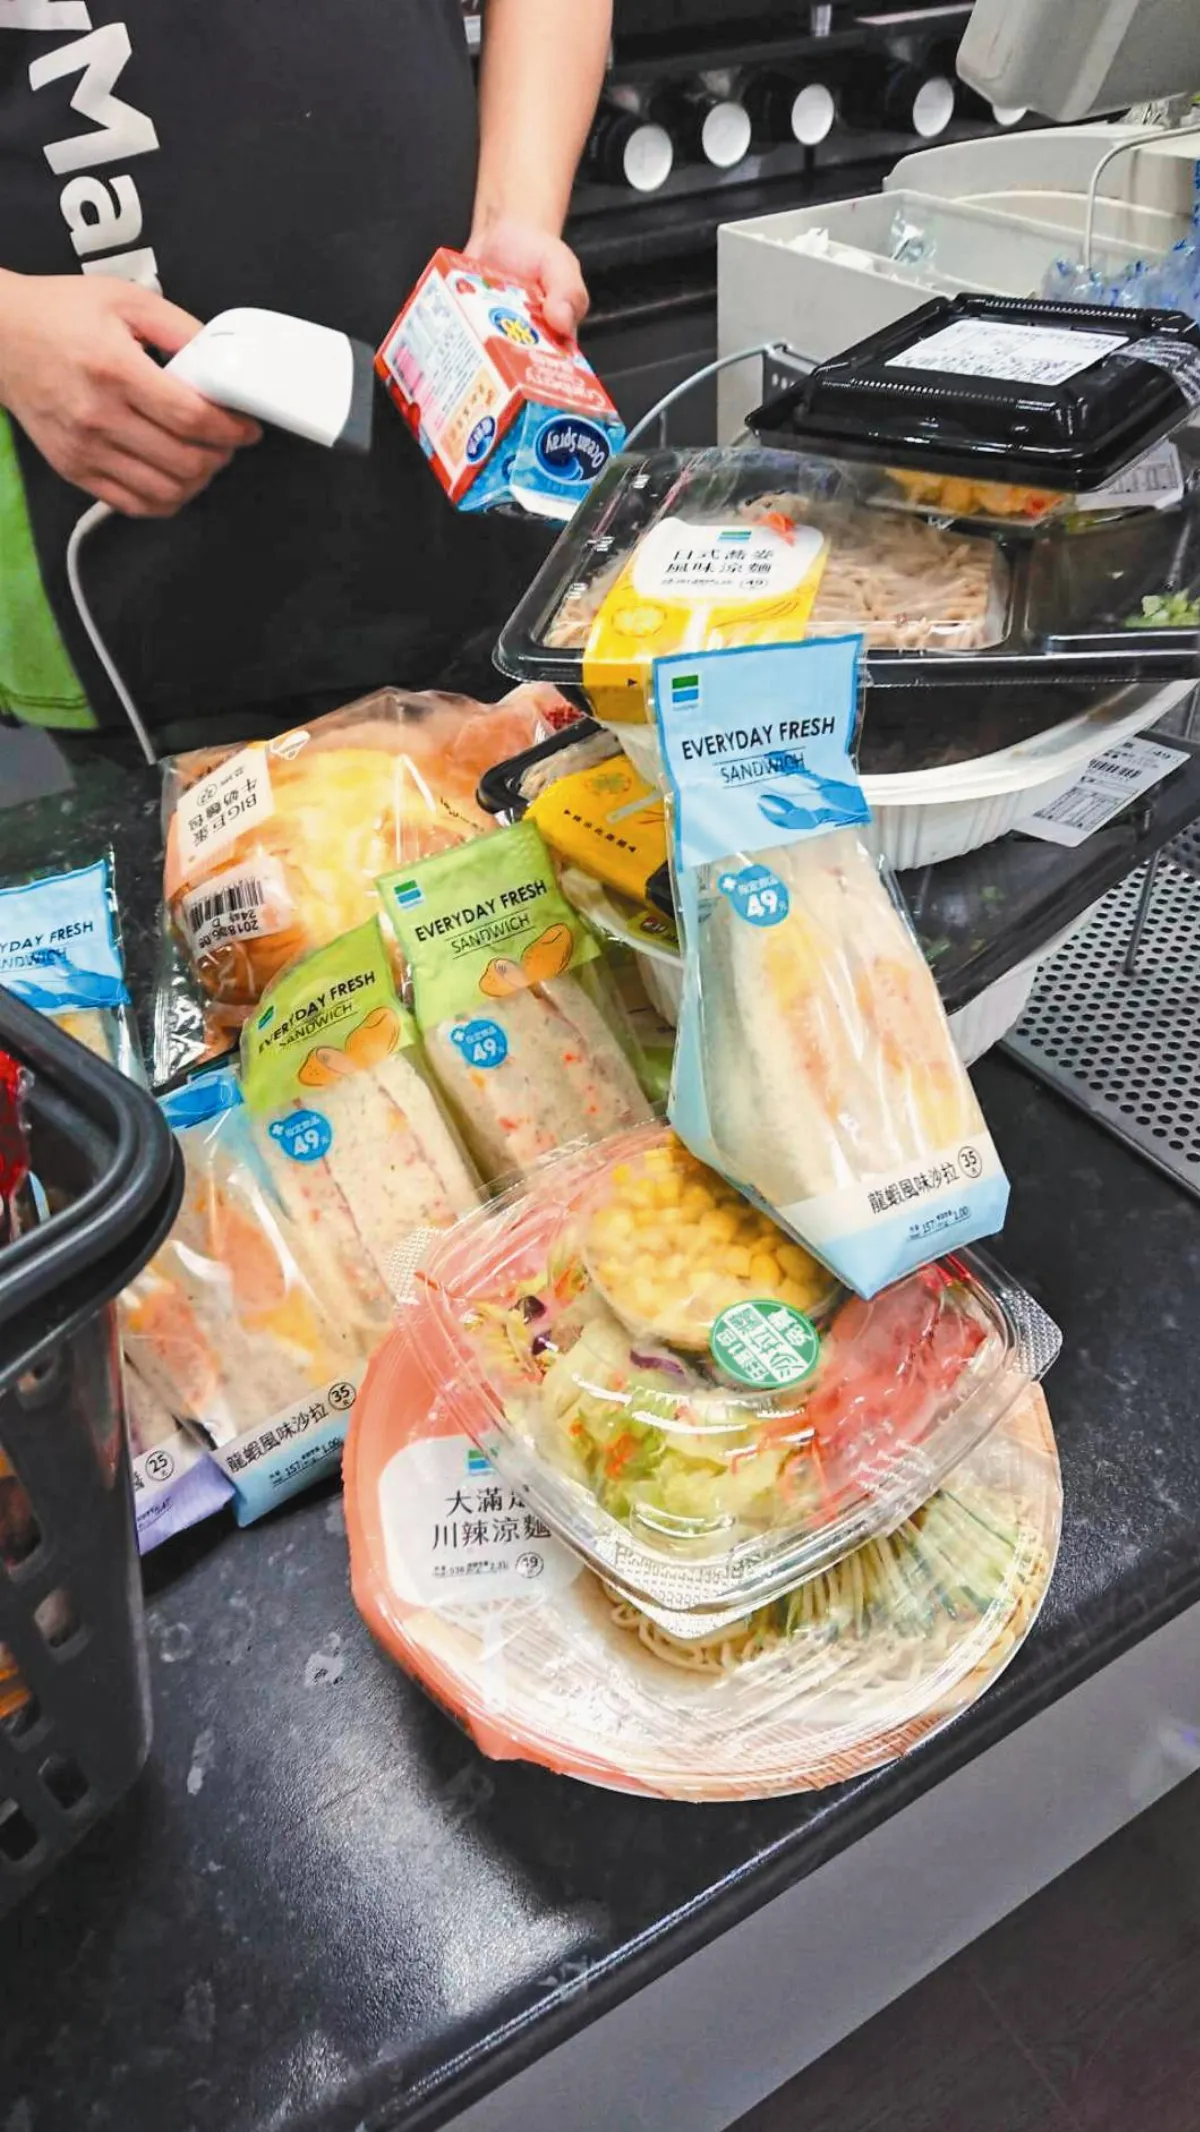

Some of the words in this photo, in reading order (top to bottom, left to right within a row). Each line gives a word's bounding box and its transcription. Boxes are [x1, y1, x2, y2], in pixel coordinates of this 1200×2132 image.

[545, 427, 578, 454] Spray
[576, 434, 606, 469] Ocean
[681, 725, 774, 760] EVERYDAY
[779, 716, 836, 742] FRESH
[720, 753, 806, 784] SANDWICH
[415, 898, 497, 942] EVERYDAY
[499, 879, 548, 909] FRESH
[746, 889, 780, 918] 49
[49, 921, 94, 944] FRESH
[451, 914, 531, 954] SANDWICH
[258, 993, 326, 1053] EVERYDAY
[330, 971, 376, 1001] FRESH
[472, 1038, 497, 1062] 49
[292, 1129, 320, 1156] 49
[867, 1162, 960, 1214] 龍蝦風味沙拉
[961, 1150, 978, 1168] 35
[225, 1402, 329, 1474] 龍蝦風味沙拉
[331, 1385, 351, 1402] 35
[151, 1456, 169, 1473] 25
[432, 1514, 552, 1550] 川辣涼麵
